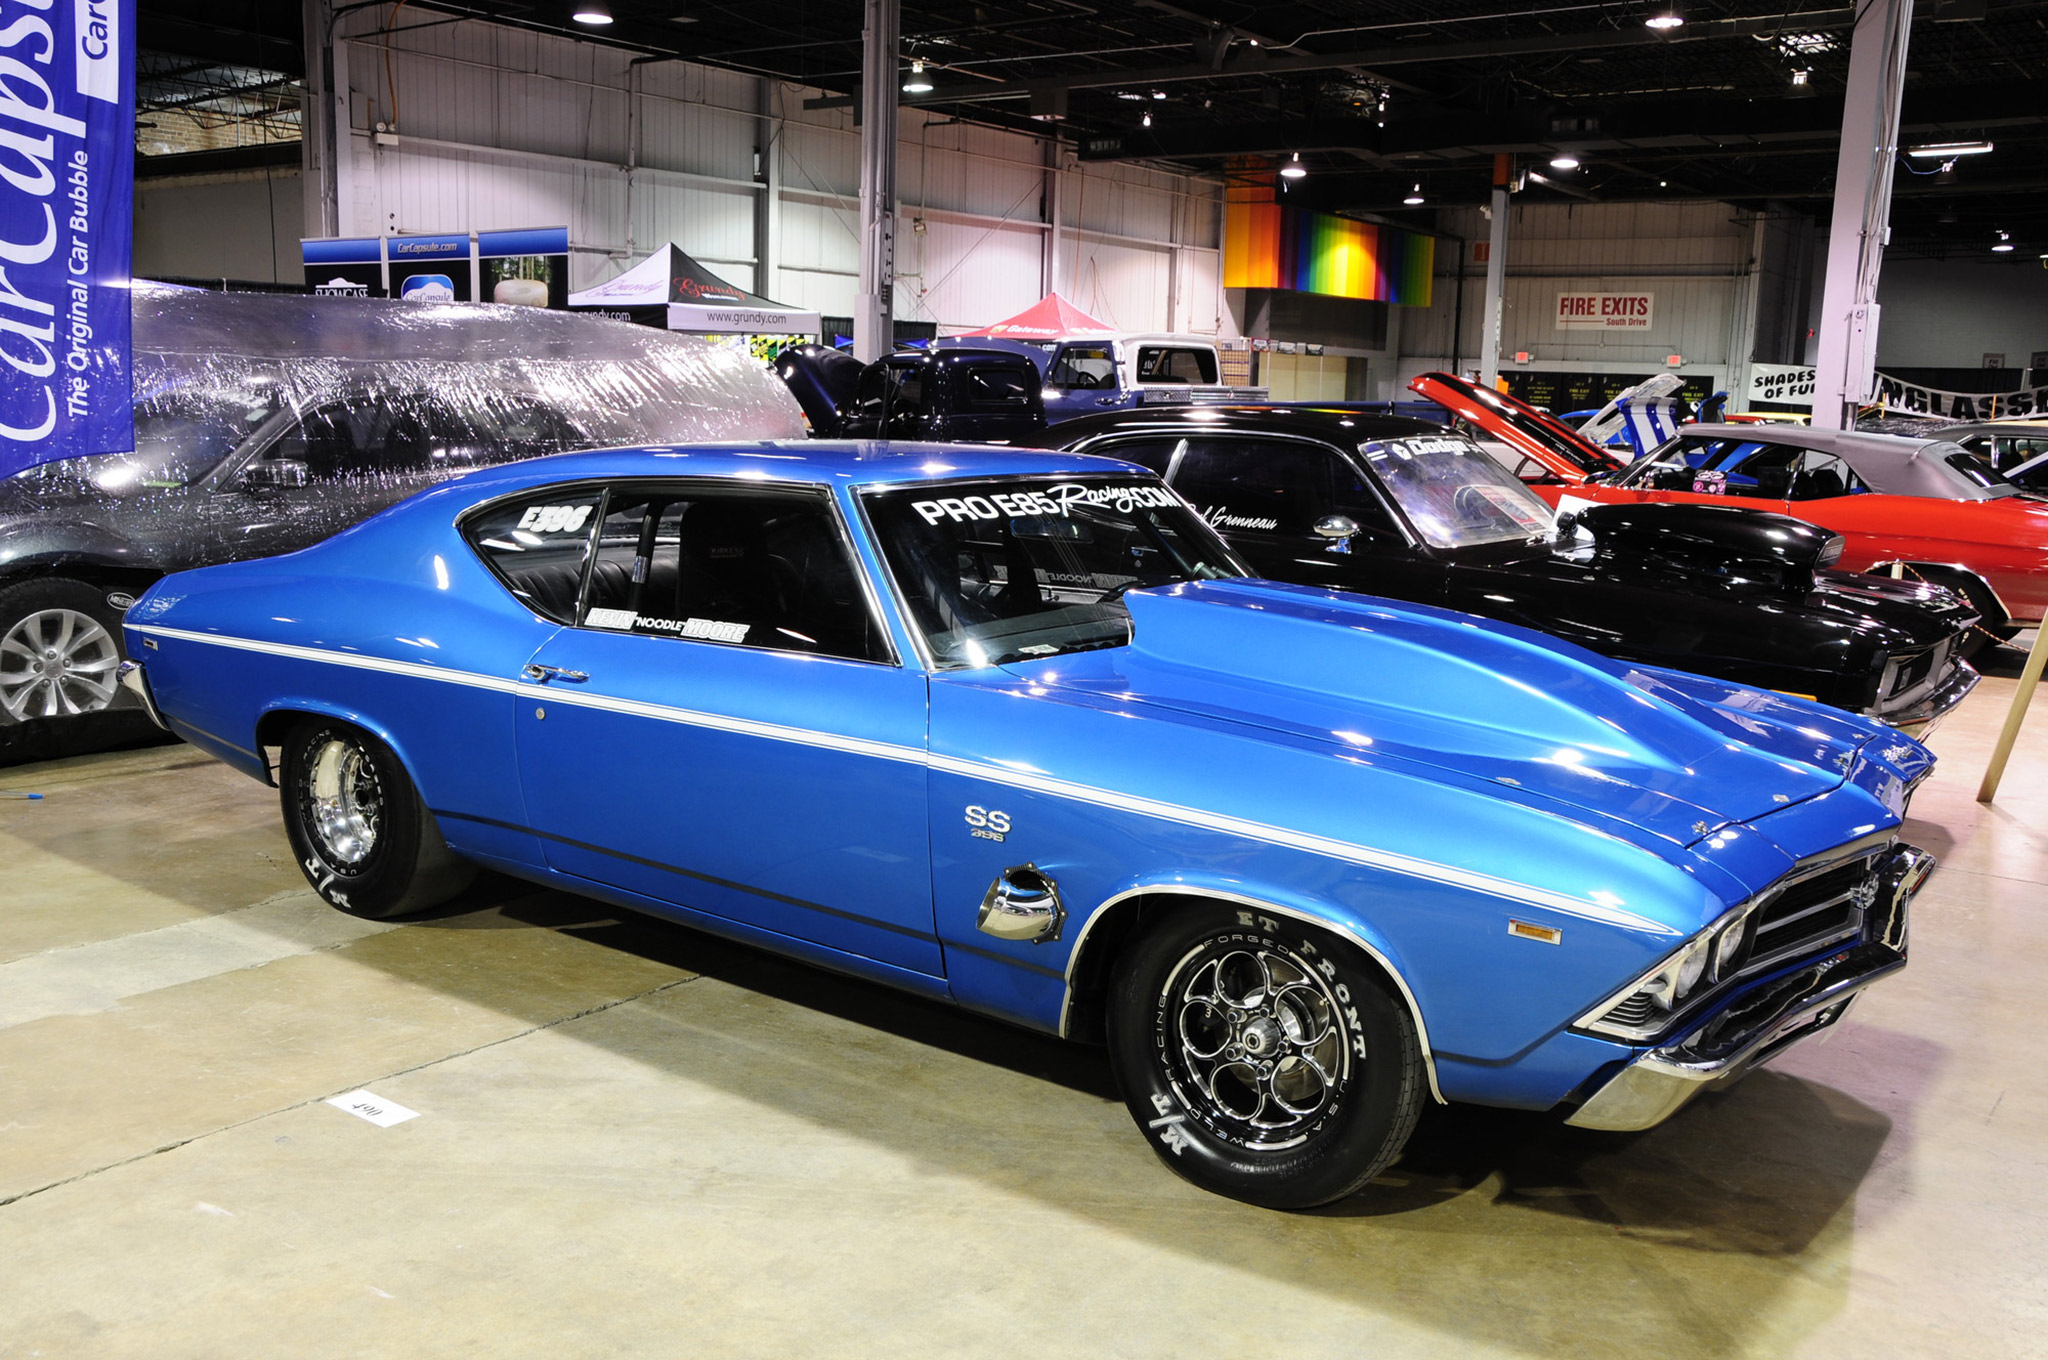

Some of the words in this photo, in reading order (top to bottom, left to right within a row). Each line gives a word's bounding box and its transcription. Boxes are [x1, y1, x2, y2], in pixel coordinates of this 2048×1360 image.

[82, 0, 109, 61] Car
[68, 150, 89, 232] Bubble
[0, 0, 87, 441] CarCaps
[68, 236, 89, 276] Car
[397, 242, 458, 254] CarCapsule.com
[674, 277, 747, 301] Grundy
[706, 310, 787, 326] www.grundy.com
[1559, 297, 1596, 316] FIRE
[1601, 297, 1648, 315] EXITS
[1606, 317, 1627, 326] South
[1628, 317, 1647, 326] Drive
[66, 281, 93, 371] Original
[1754, 369, 1816, 388] SHADES
[1764, 387, 1784, 399] OF
[67, 377, 89, 417] The
[1406, 439, 1471, 456] Dodge
[911, 496, 1000, 526] PRO
[584, 607, 638, 630] KEVIN
[680, 618, 751, 643] MOORE
[964, 805, 1011, 833] SS
[1203, 933, 1290, 955] FORGED
[1236, 911, 1279, 933] ET
[1300, 938, 1367, 1060] FRONT
[1154, 996, 1177, 1083] RACING
[1188, 1108, 1246, 1147] WELD
